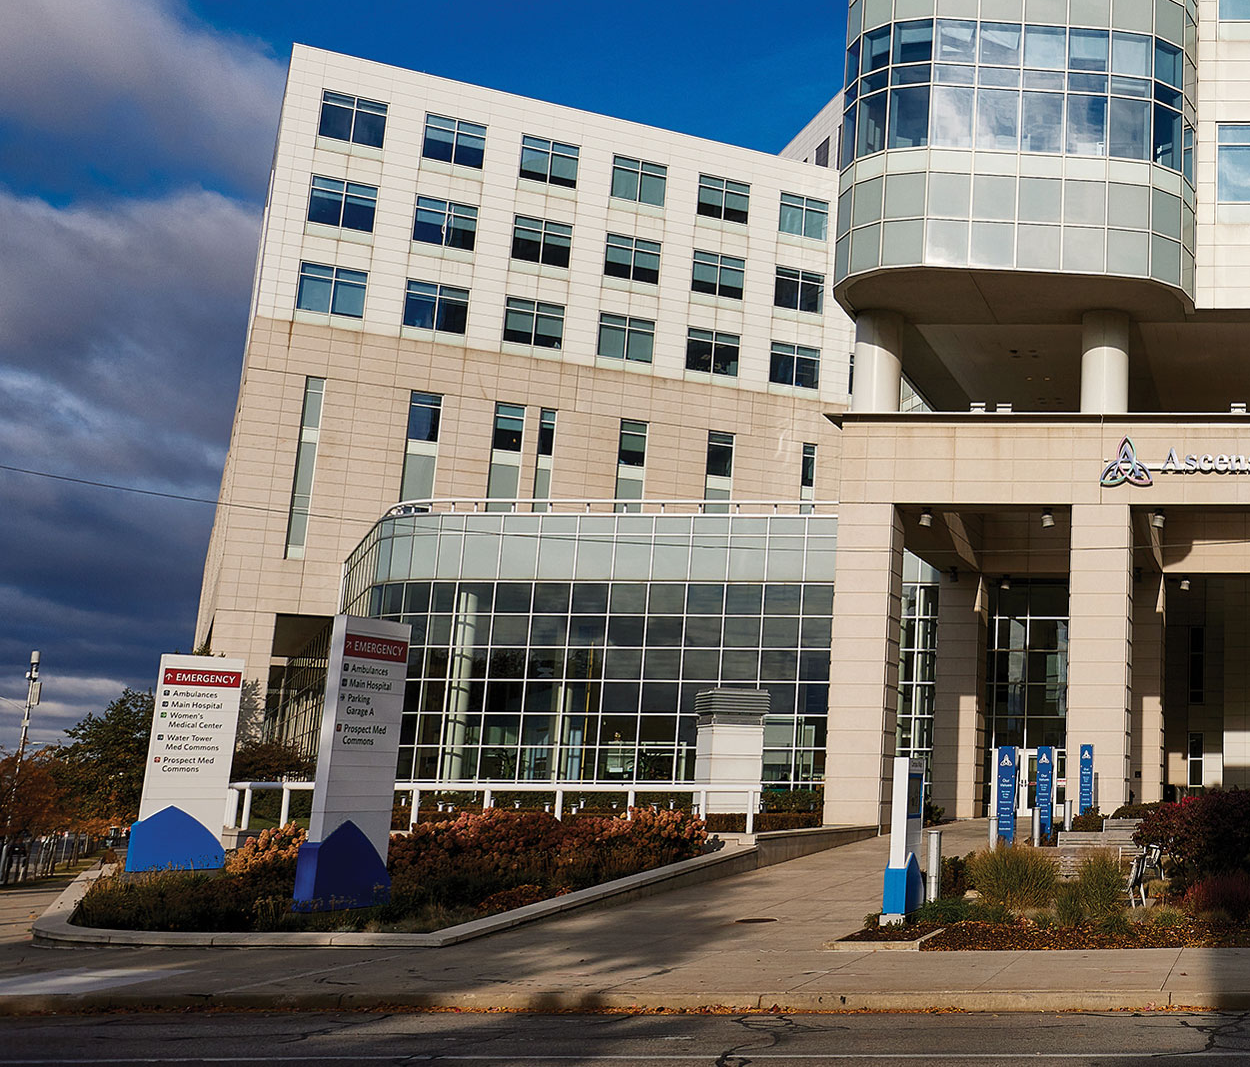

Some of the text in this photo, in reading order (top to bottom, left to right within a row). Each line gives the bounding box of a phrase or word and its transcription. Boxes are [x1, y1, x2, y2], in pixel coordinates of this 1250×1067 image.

[354, 640, 404, 656] EMERGENCY
[350, 664, 389, 676] Ambulances
[176, 673, 236, 684] EMERGENCY
[349, 679, 392, 692] Main Hospital
[173, 690, 218, 698] Ambulances
[347, 693, 371, 705] Parking
[192, 702, 223, 710] Hospital
[346, 706, 375, 717] Garage A
[343, 724, 387, 735] Prospect Med
[342, 735, 374, 746] Commons
[163, 756, 196, 764] Prospect
[161, 765, 199, 773] Commons
